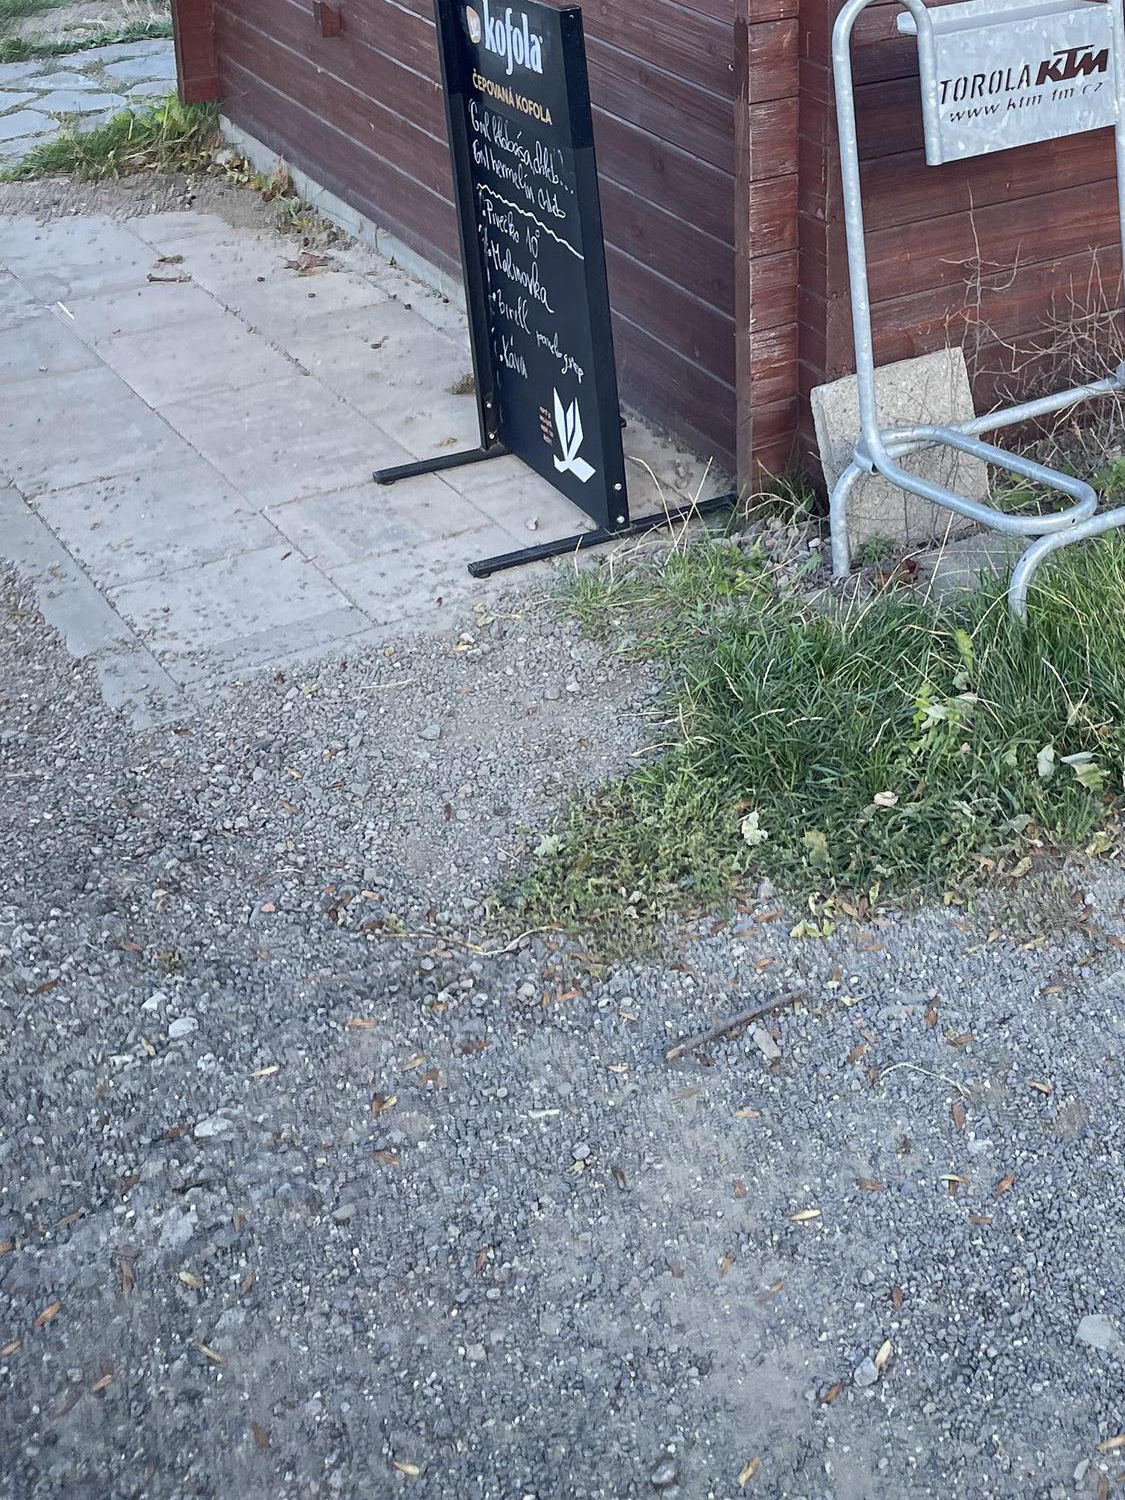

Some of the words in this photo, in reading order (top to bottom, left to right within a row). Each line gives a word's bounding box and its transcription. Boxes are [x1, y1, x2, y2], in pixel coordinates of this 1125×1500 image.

[472, 68, 515, 108] ČEPOVANÁ
[515, 93, 553, 126] KOFOLA
[939, 64, 1030, 105] TOROLA
[1035, 44, 1109, 86] KTM
